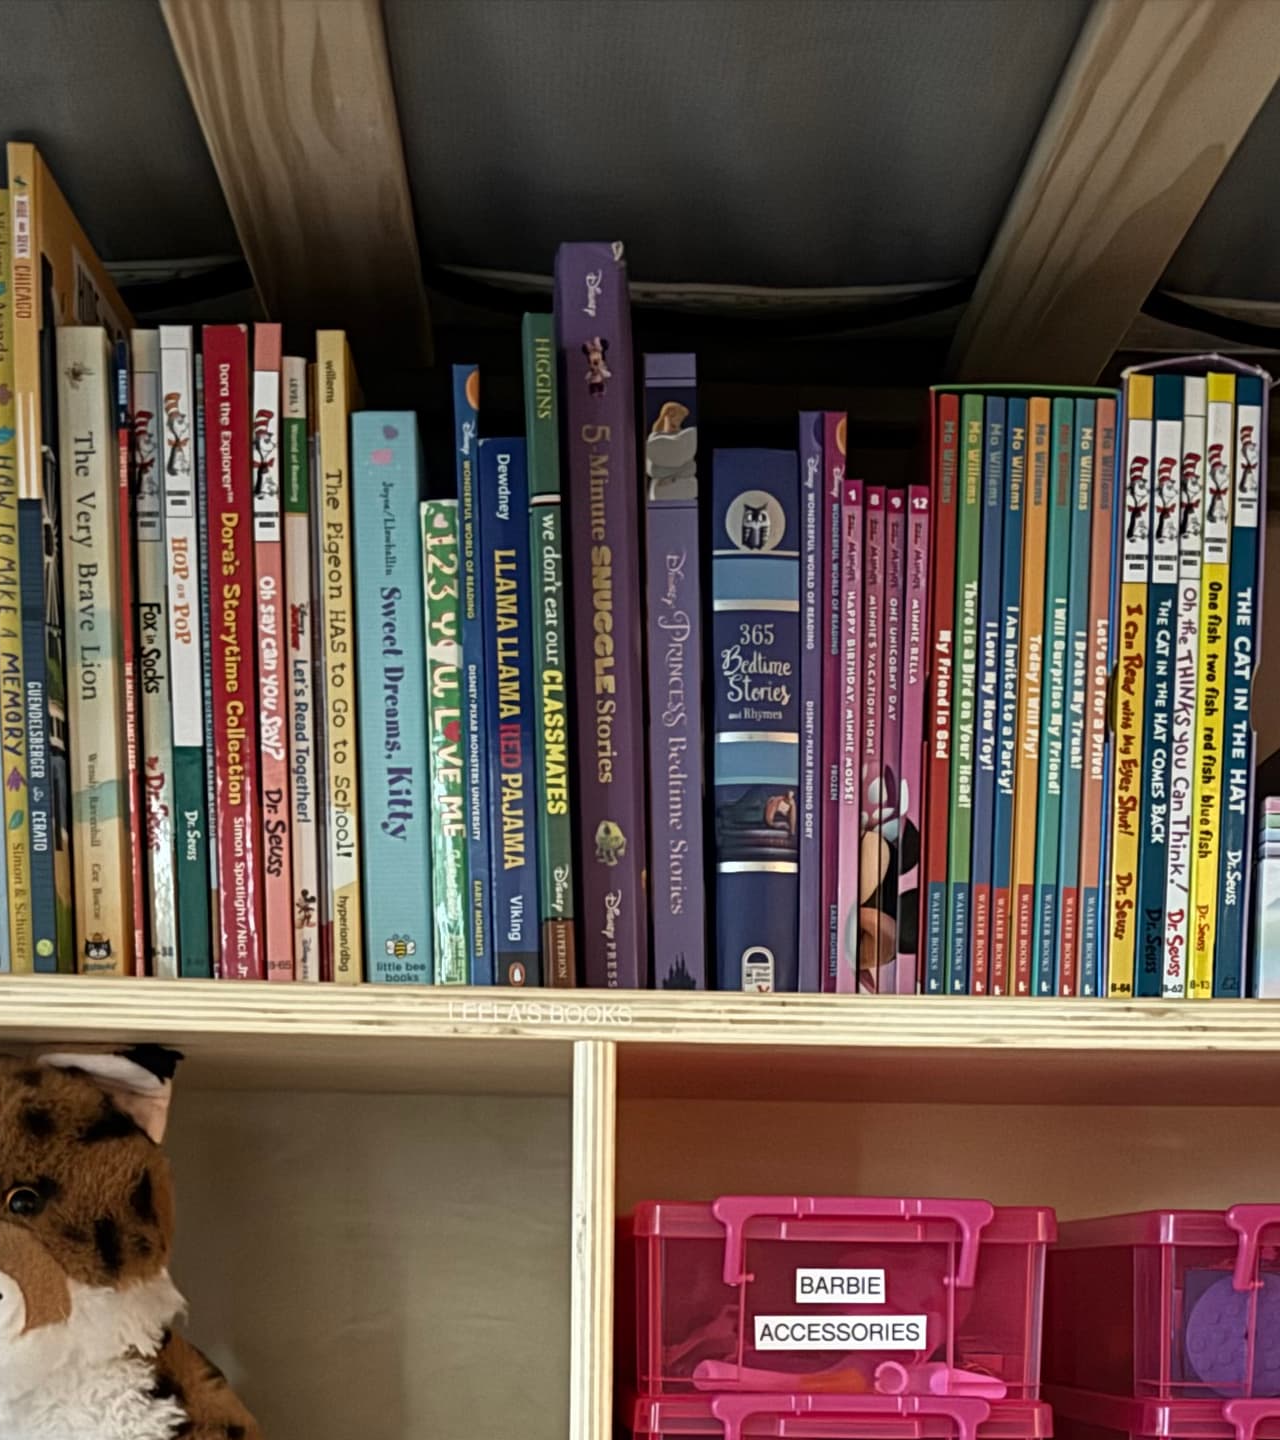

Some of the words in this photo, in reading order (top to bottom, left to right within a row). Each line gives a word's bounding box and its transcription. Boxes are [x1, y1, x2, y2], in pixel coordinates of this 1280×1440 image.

[14, 265, 31, 319] CHICAGO
[324, 360, 337, 403] willems
[535, 338, 552, 419] HIGGINS
[73, 431, 95, 476] The
[1012, 428, 1024, 449] Mo
[327, 469, 342, 509] The
[462, 460, 474, 520] WONDERFUL
[496, 454, 511, 520] Dewdney
[1010, 456, 1023, 510] Willems
[0, 523, 16, 545] TO
[69, 492, 97, 548] Very
[464, 523, 475, 557] WORLD
[542, 513, 557, 541] we
[172, 537, 190, 578] HOP
[222, 513, 239, 575] Dora's
[324, 522, 344, 599] Pigeon
[425, 533, 457, 600] 123
[466, 560, 476, 573] OF
[543, 546, 562, 593] don't
[78, 563, 99, 631] Brave
[259, 576, 276, 600] Oh
[465, 576, 476, 619] READING
[495, 549, 517, 632] LLAMA
[1208, 582, 1222, 609] One
[1237, 587, 1252, 625] THE
[139, 603, 162, 631] Fox
[175, 604, 192, 644] POP
[260, 604, 276, 634] say
[380, 587, 404, 656] Sweet
[544, 598, 560, 628] eat
[591, 546, 616, 693] SNUGGLE
[1006, 617, 1018, 639] Am
[1127, 604, 1142, 616] I
[1207, 615, 1222, 644] fish
[7, 628, 19, 638] A
[146, 635, 155, 644] in
[221, 583, 242, 692] Storytime
[330, 610, 346, 653] HAS
[546, 632, 560, 664] our
[740, 624, 774, 645] 365
[1179, 617, 1198, 644] the
[80, 645, 103, 700] Lion
[140, 648, 165, 693] Socks
[262, 638, 279, 669] can
[721, 645, 792, 676] Bedtime
[1003, 645, 1017, 699] Invited
[1205, 653, 1219, 681] two
[1233, 636, 1251, 680] CAT
[262, 676, 278, 710] you
[293, 659, 309, 697] Let's
[331, 663, 347, 687] to
[497, 637, 521, 719] LLAMA
[728, 674, 791, 705] Stories
[1122, 653, 1143, 696] Read
[1174, 651, 1195, 727] THINKS
[3, 653, 24, 757] MEMORY
[332, 699, 348, 727] Go
[384, 666, 406, 760] Dreams,
[1003, 704, 1014, 719] to
[1121, 700, 1134, 729] with
[1204, 688, 1218, 716] fish
[1234, 688, 1248, 711] IN
[27, 682, 45, 778] GUENDELSBERGER
[261, 712, 285, 760] Say?
[295, 702, 308, 742] Read
[596, 700, 617, 783] Stories
[1003, 726, 1012, 735] a
[1203, 727, 1215, 750] red
[1232, 721, 1246, 759] THE
[226, 701, 244, 805] Collection
[334, 740, 350, 764] to
[470, 735, 480, 784] MONSTERS
[500, 723, 522, 769] RED
[543, 670, 567, 815] CLASSMATES
[1119, 734, 1136, 755] My
[1172, 731, 1191, 770] you
[295, 747, 310, 823] Together!
[668, 736, 687, 830] Bedtime
[998, 740, 1014, 794] Party!
[1119, 759, 1138, 792] Eyes
[1201, 755, 1216, 784] fish
[265, 789, 282, 814] Dr.
[381, 767, 414, 841] Kitty
[1170, 777, 1186, 811] Can
[1200, 795, 1215, 825] blue
[1229, 769, 1246, 815] HAT
[32, 811, 48, 851] CERATO
[185, 811, 198, 827] Dr.
[334, 776, 354, 857] School!
[440, 796, 466, 838] ME
[472, 787, 481, 841] UNIVERSITY
[501, 773, 525, 870] PAJAMA
[1118, 796, 1137, 836] Shut!
[187, 830, 201, 860] Seuss
[234, 816, 245, 857] Simon
[266, 820, 285, 877] Seuss
[1169, 819, 1190, 893] Think!
[1198, 830, 1213, 859] fish
[552, 864, 569, 912] Disney
[669, 839, 688, 915] Stories
[1117, 873, 1132, 895] Dr.
[337, 896, 351, 972] hyperion/dbg
[508, 896, 523, 941] Viking
[995, 898, 1004, 937] WALKER
[1114, 900, 1133, 940] Seuss
[1168, 909, 1184, 931] Dr.
[237, 962, 249, 978] Jr.
[376, 962, 402, 972] little
[405, 962, 426, 971] bee
[555, 924, 567, 978] HYPERION
[994, 941, 1004, 976] BOOKS
[1167, 935, 1183, 977] Seuss
[385, 973, 419, 982] books
[550, 1005, 632, 1025] BOOKS
[800, 1276, 881, 1295] BARBIE
[759, 1322, 920, 1342] ACCESSORIES
